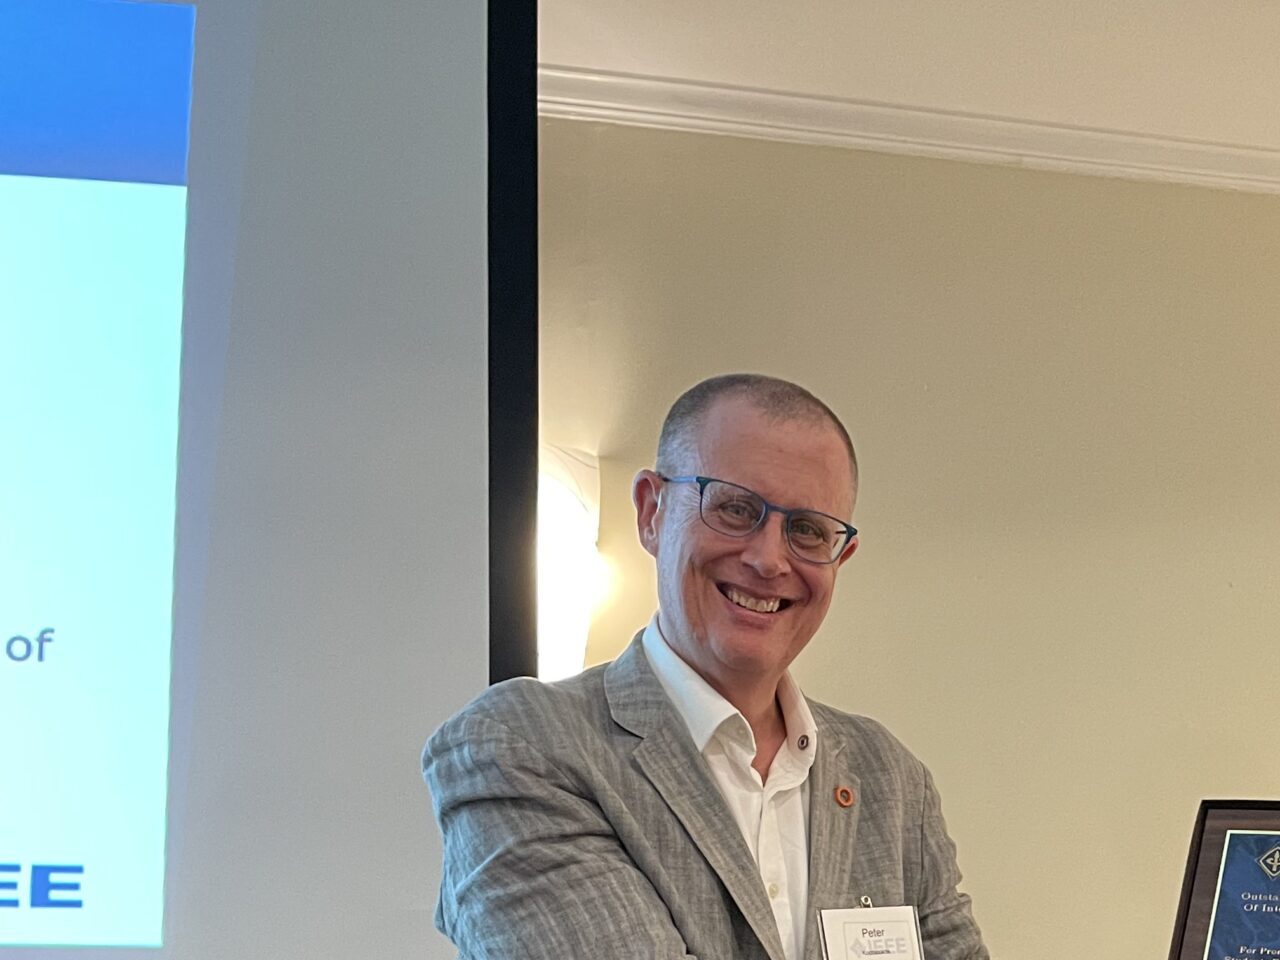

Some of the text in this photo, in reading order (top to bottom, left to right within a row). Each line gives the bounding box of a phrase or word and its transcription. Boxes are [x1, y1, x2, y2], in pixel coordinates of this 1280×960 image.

[6, 627, 55, 662] of
[1243, 903, 1258, 912] Of
[861, 928, 885, 938] Peter
[1239, 945, 1257, 955] For
